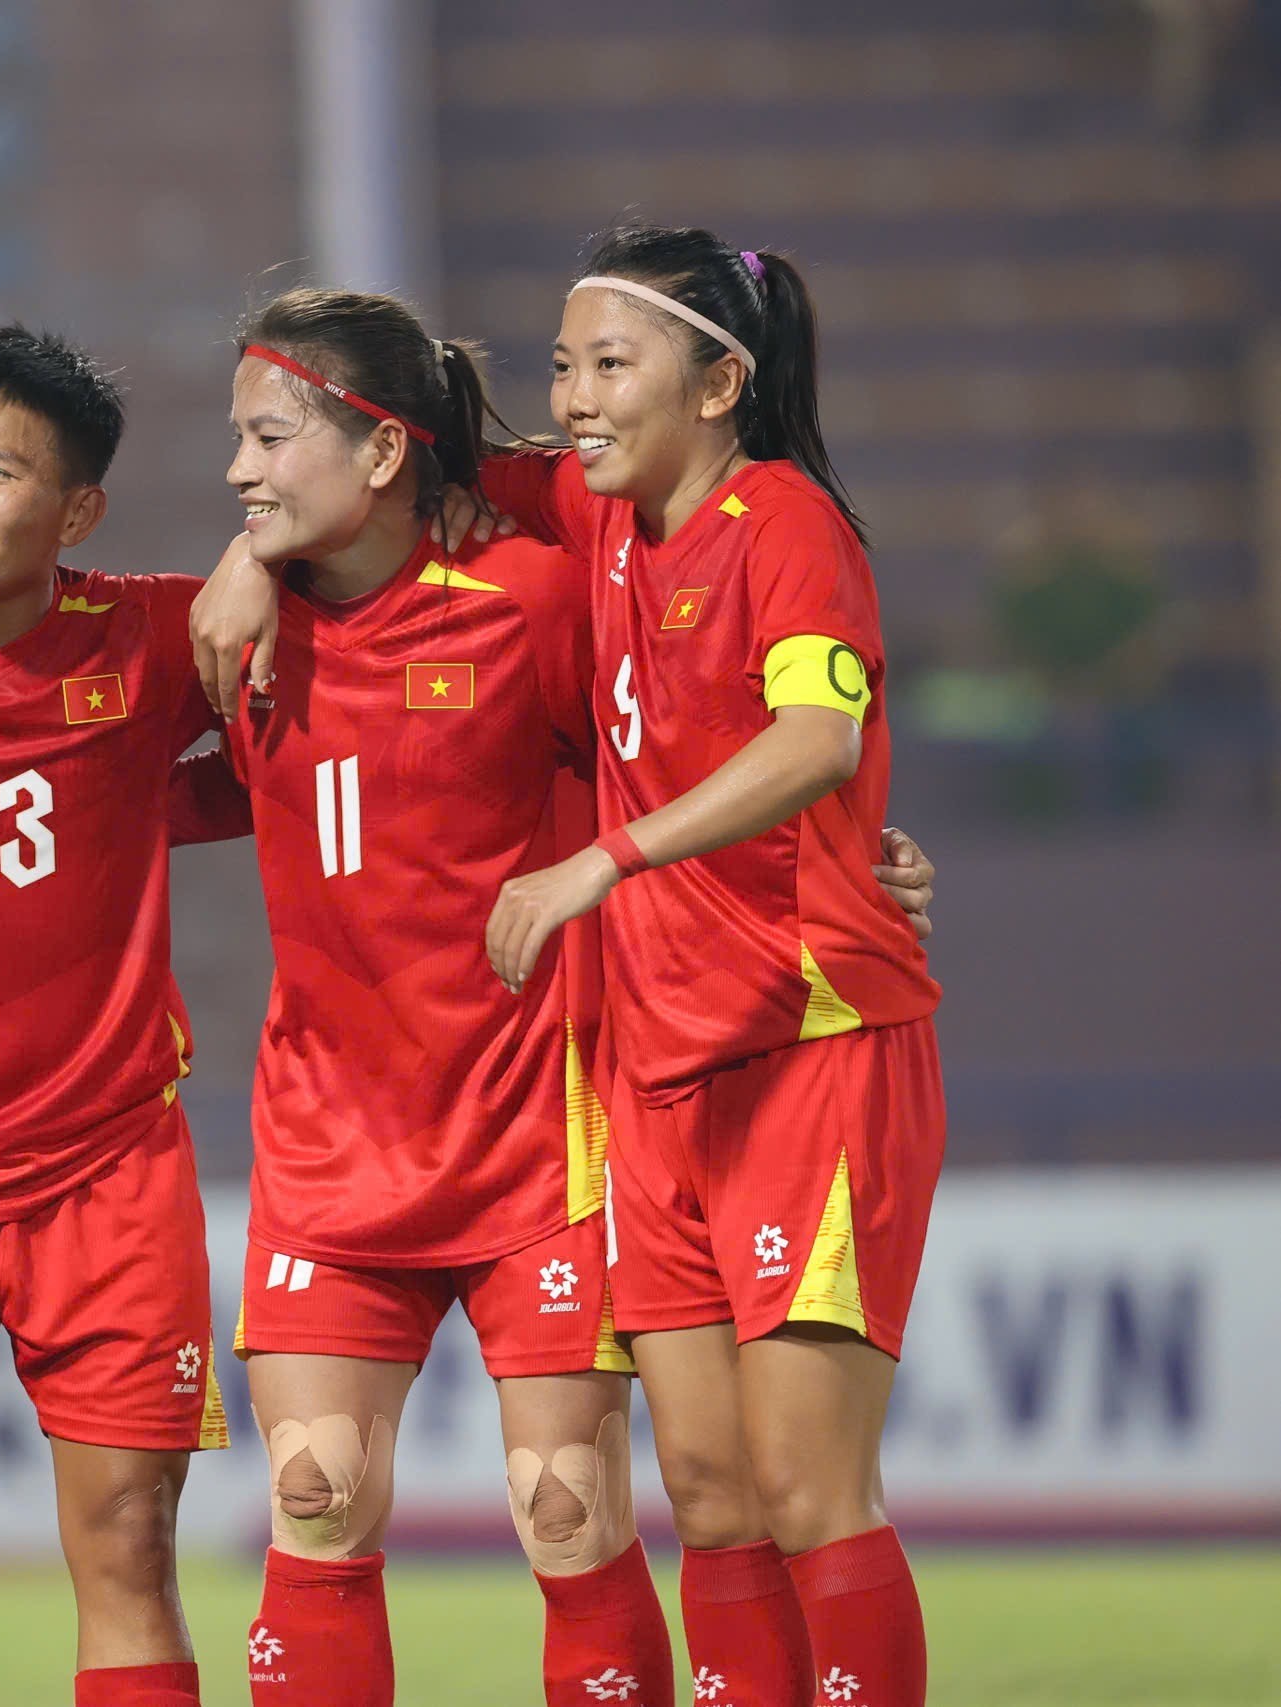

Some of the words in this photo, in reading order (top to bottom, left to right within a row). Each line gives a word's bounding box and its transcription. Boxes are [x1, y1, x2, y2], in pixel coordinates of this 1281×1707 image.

[323, 381, 347, 399] NIKE
[828, 644, 863, 702] C
[315, 754, 362, 879] 11
[538, 1301, 581, 1314] JOGARBOLA
